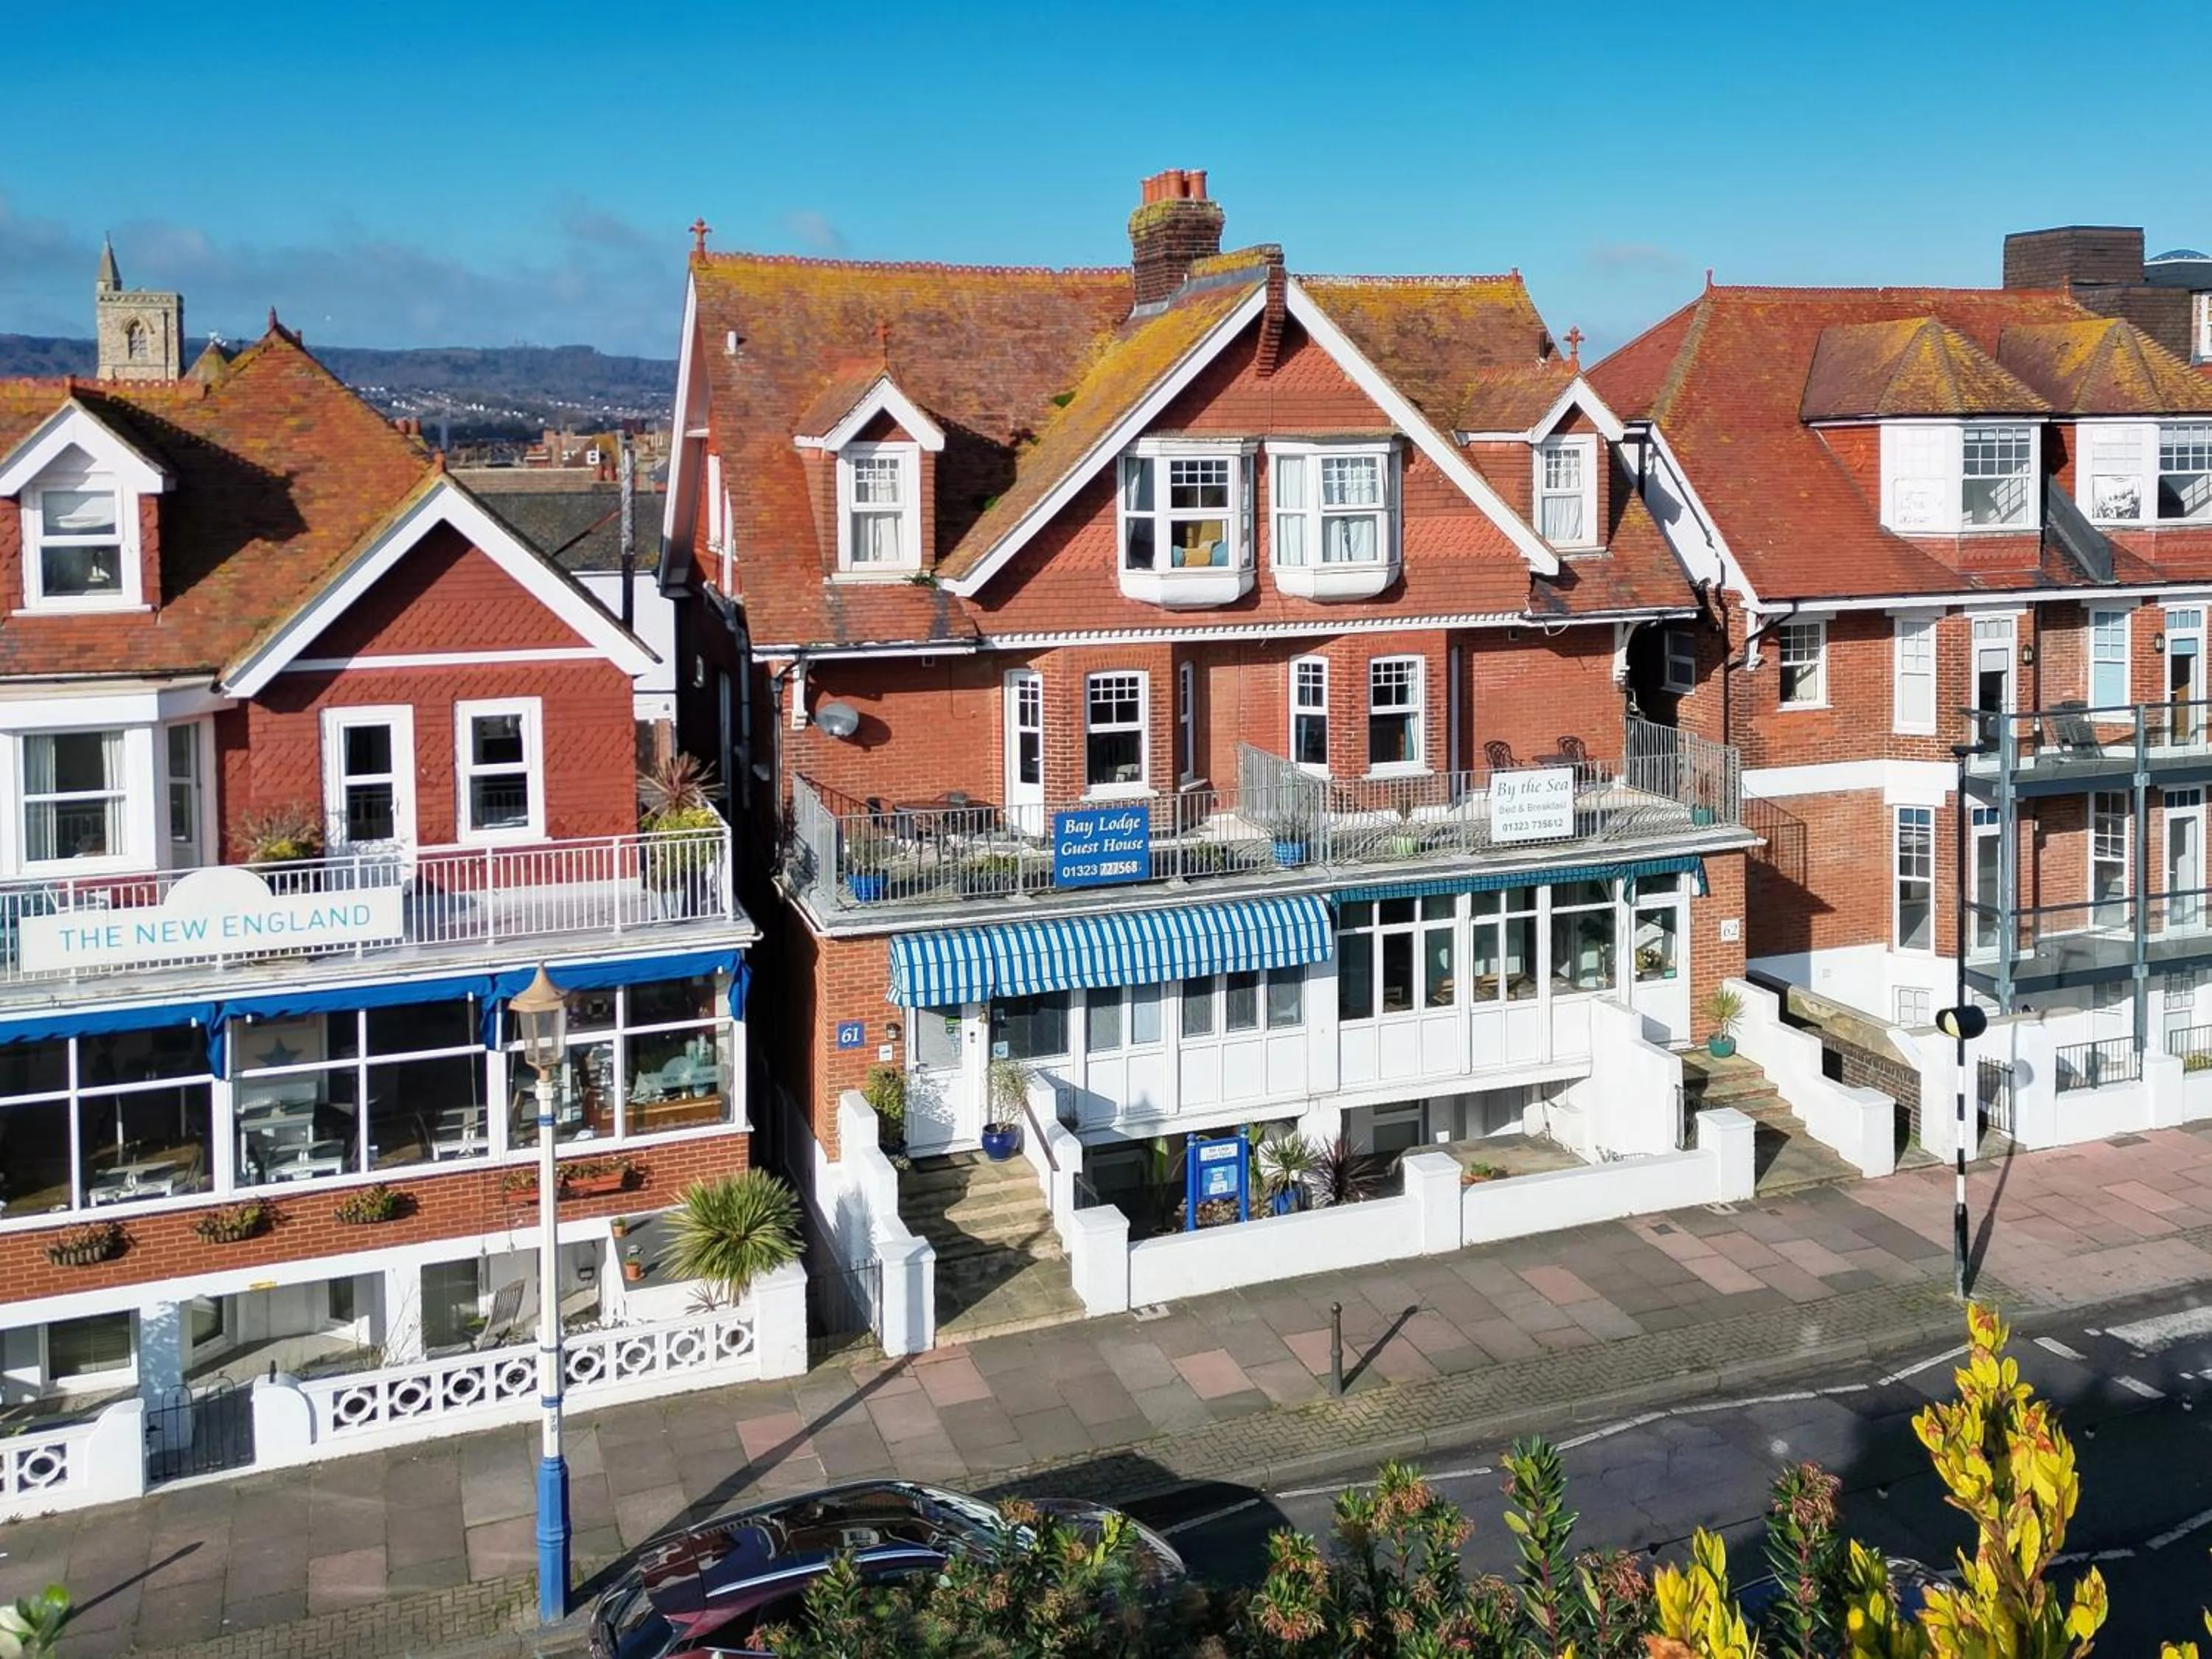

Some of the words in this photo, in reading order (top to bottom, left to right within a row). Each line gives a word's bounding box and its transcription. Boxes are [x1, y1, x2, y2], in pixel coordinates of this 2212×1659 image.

[1497, 782, 1516, 802] By
[1521, 777, 1542, 794] the
[1546, 778, 1569, 793] Sea
[1064, 818, 1093, 839] Bay
[1098, 813, 1141, 836] Lodge
[1502, 821, 1529, 832] 01323
[1061, 841, 1099, 856] Guest
[1102, 838, 1144, 852] House
[1062, 863, 1098, 878] 01323
[59, 925, 123, 952] THE
[136, 917, 209, 945] NEW
[223, 904, 370, 937] ENGLAND
[1723, 922, 1738, 937] 62
[841, 1027, 860, 1044] 61
